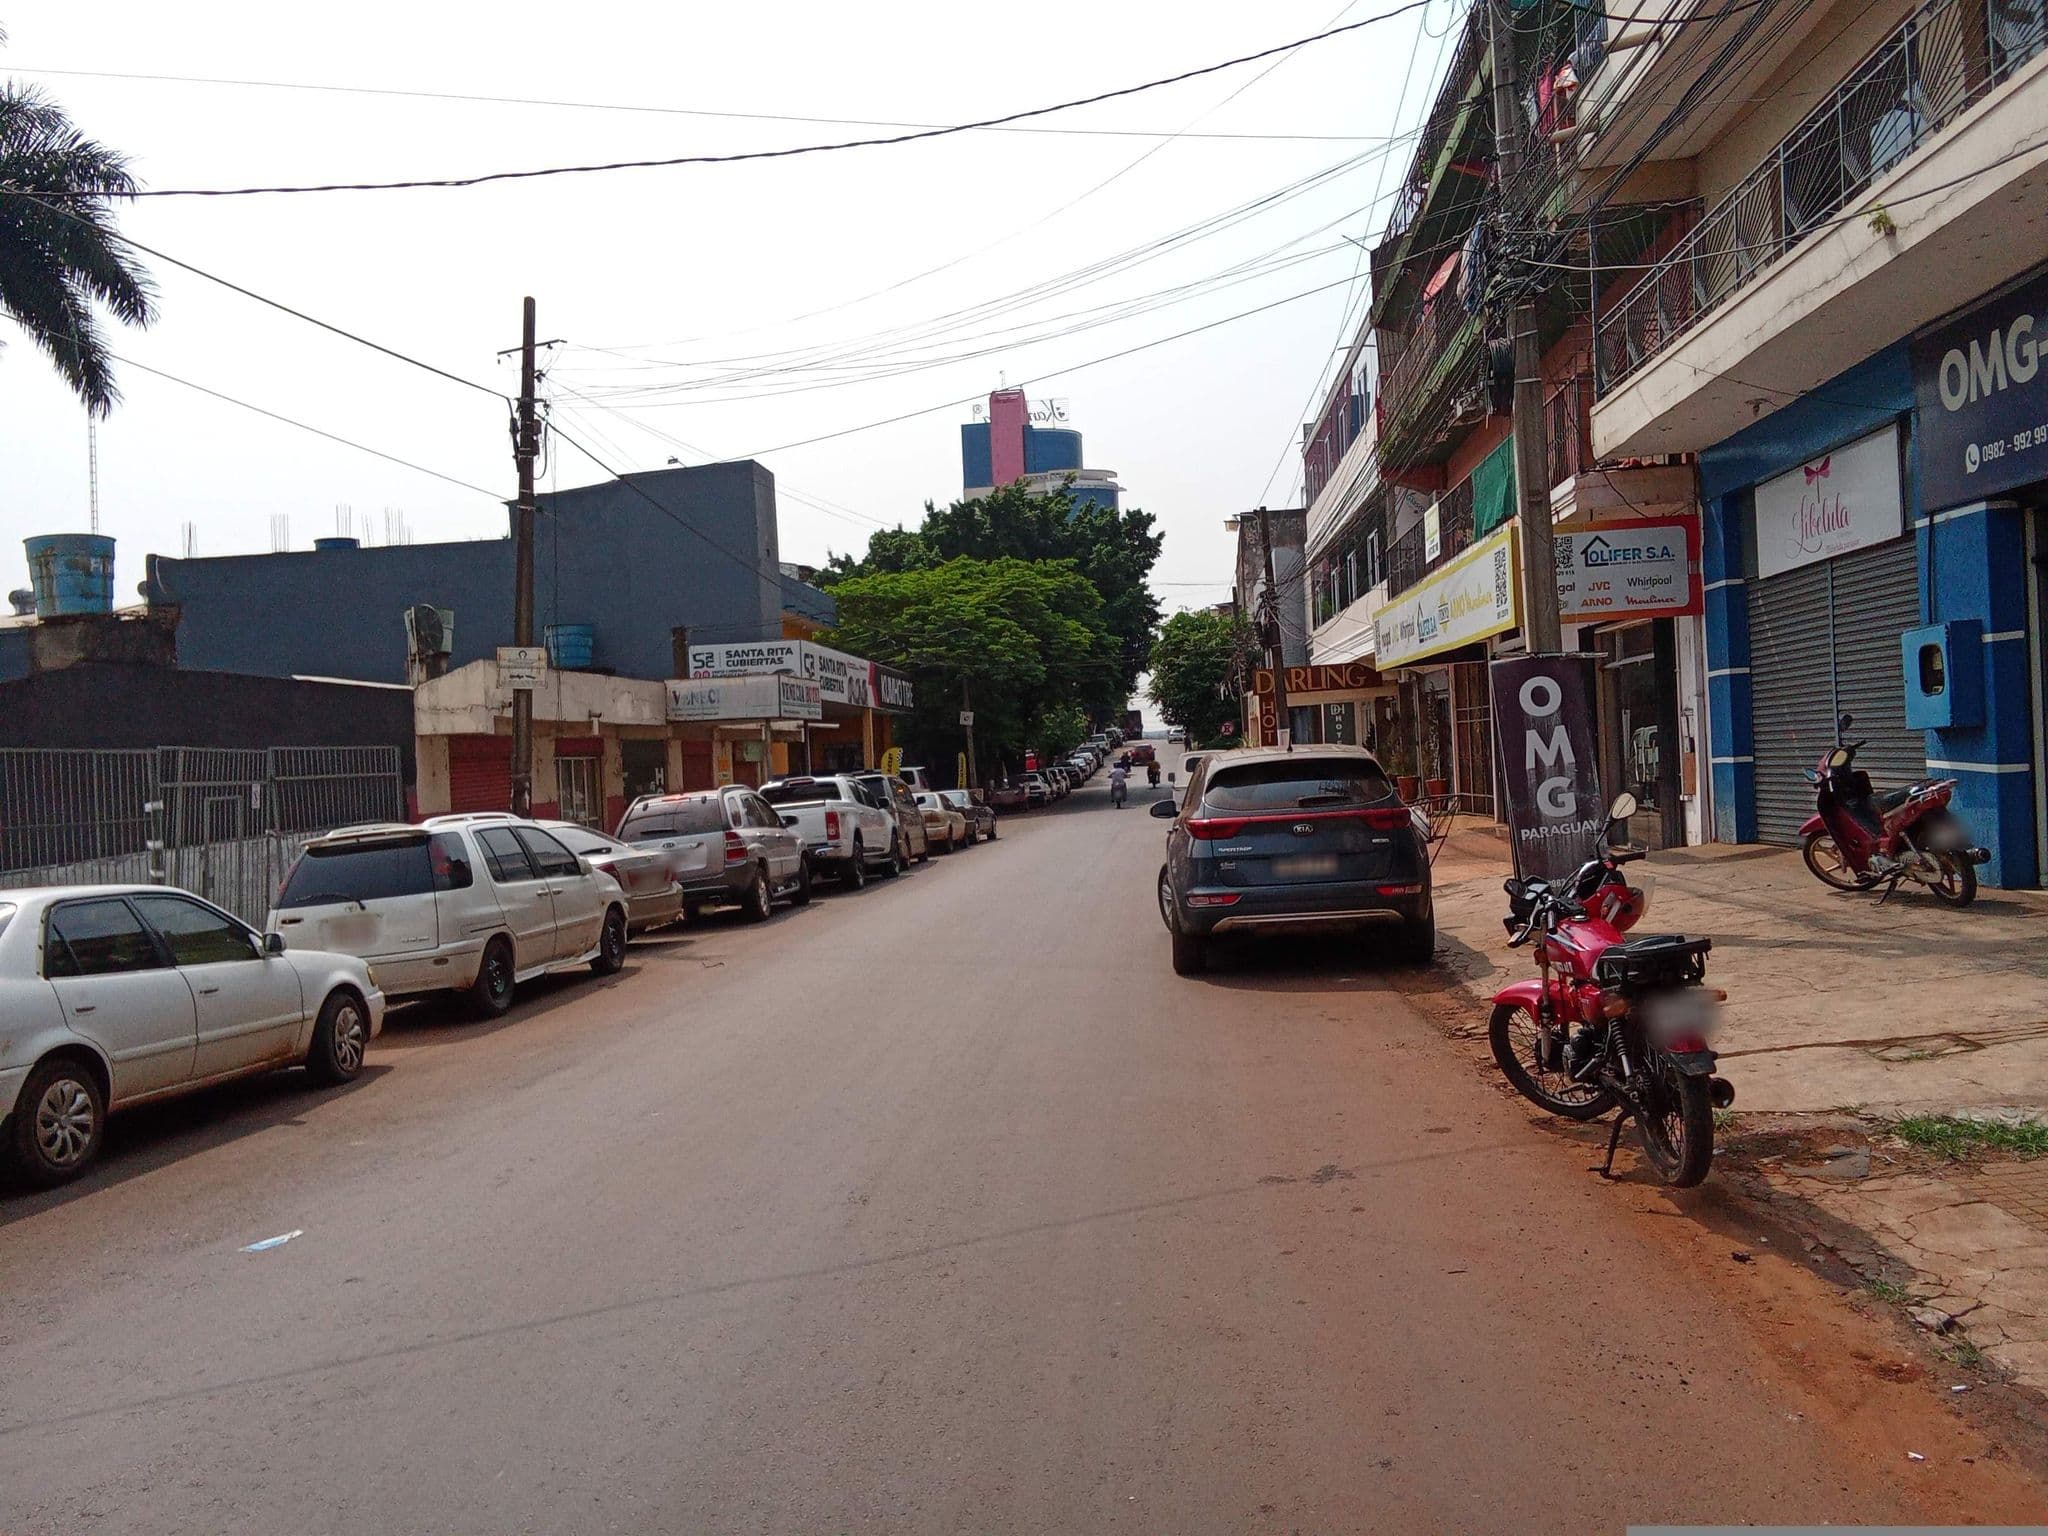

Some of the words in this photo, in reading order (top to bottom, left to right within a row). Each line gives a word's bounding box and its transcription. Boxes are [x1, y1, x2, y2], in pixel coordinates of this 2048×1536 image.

[1982, 439, 2005, 462] 0982
[2013, 430, 2032, 451] 992
[2034, 424, 2048, 445] 99
[1589, 548, 1642, 562] OLIFER
[1646, 546, 1676, 559] S.A.
[1557, 582, 1576, 595] gal
[1588, 581, 1611, 591] JVC
[1626, 575, 1672, 588] Whirlpool
[1581, 597, 1613, 607] ARNO
[725, 649, 765, 659] SANTA
[767, 647, 794, 656] RITA
[726, 657, 785, 668] CUBIERTAS
[1519, 676, 1577, 817] OMG
[1521, 819, 1600, 841] PARAGUAY
